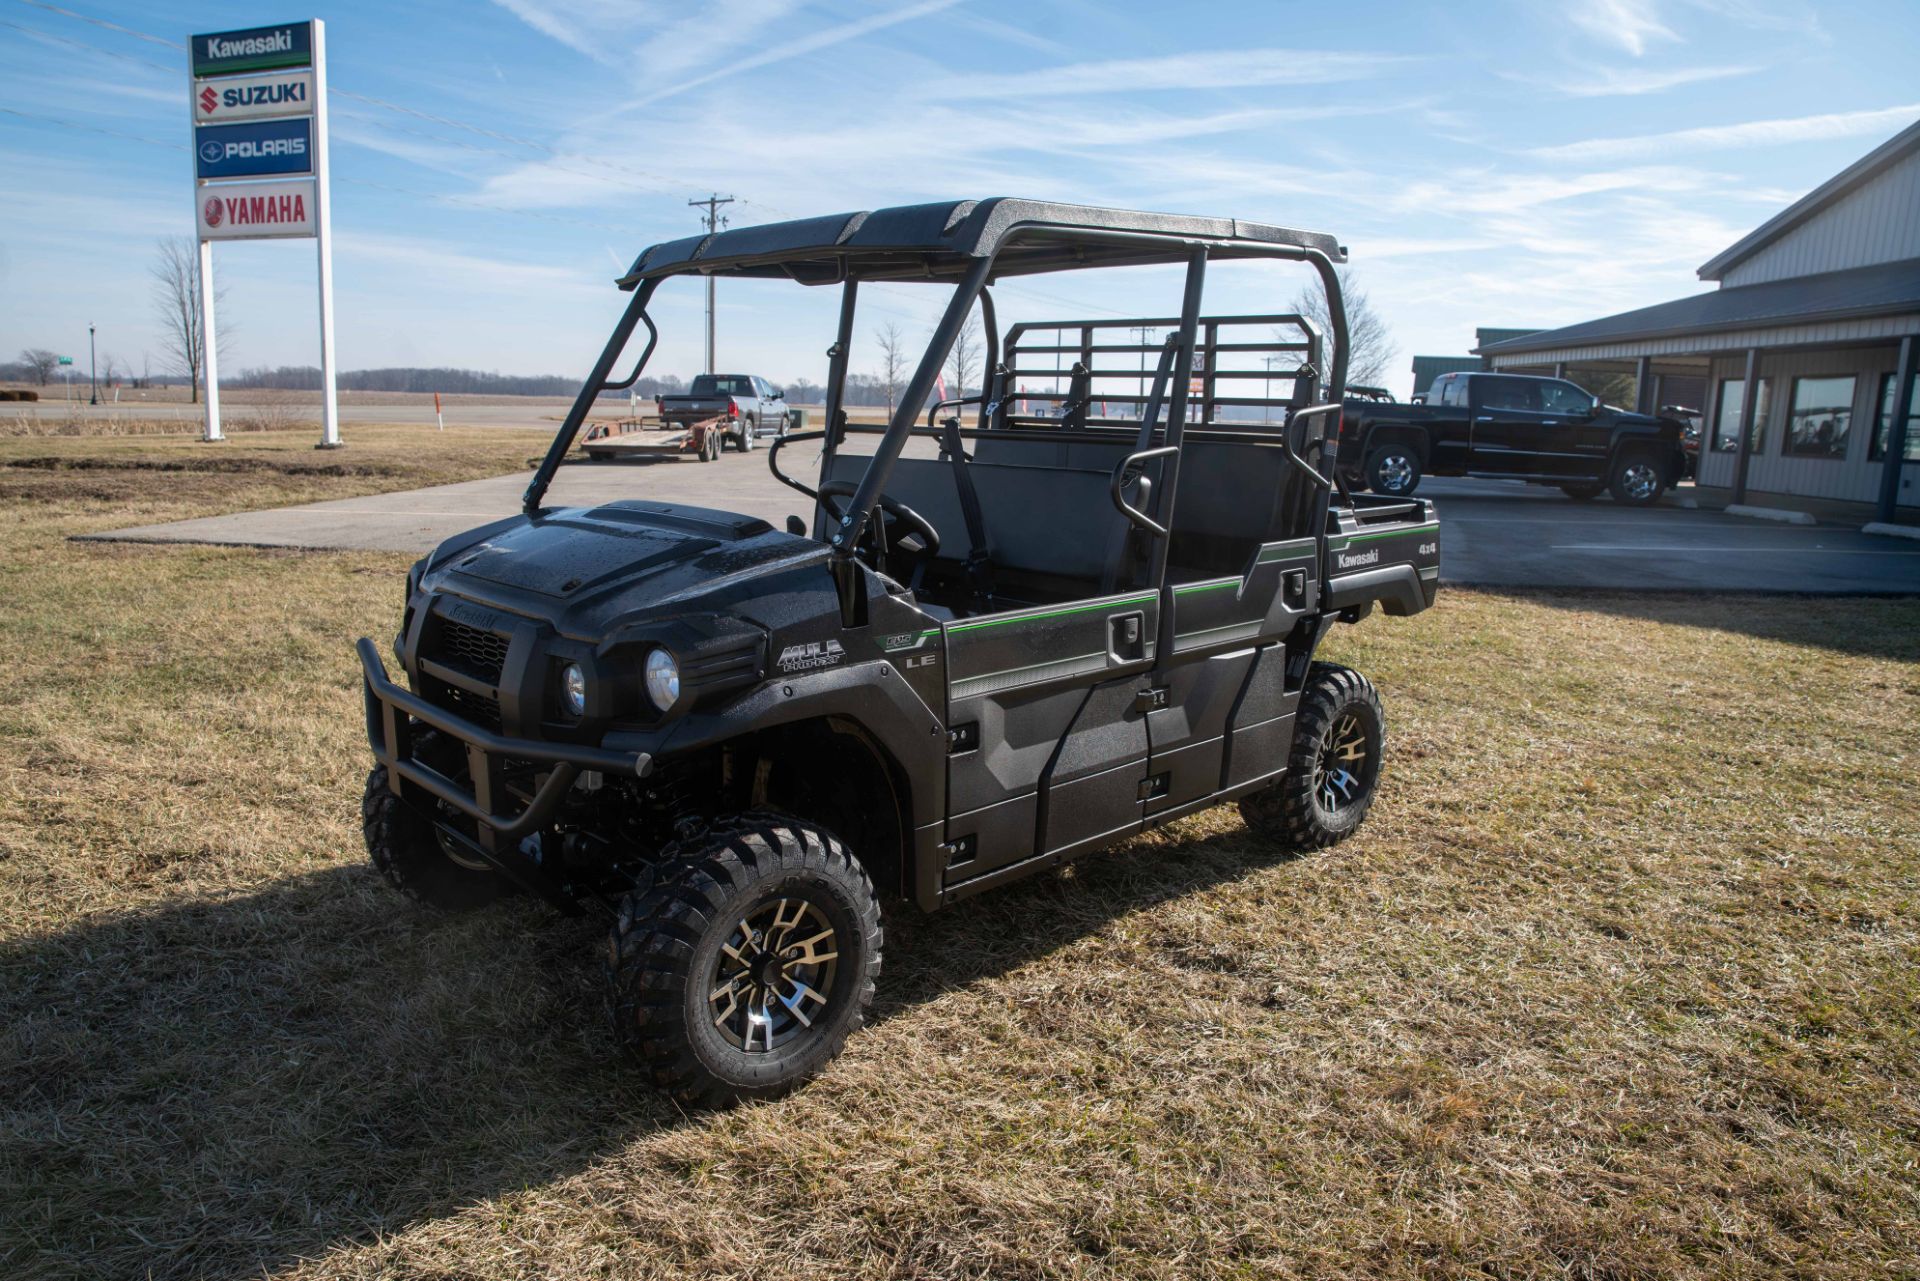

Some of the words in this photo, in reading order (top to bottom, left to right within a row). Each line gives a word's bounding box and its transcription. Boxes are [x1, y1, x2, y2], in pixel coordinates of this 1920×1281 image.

[208, 29, 292, 59] Kawasaki
[223, 82, 305, 108] SUZUKI
[225, 138, 305, 159] POLARIS
[226, 194, 305, 225] YAMAHA
[1338, 548, 1379, 568] Kawasaki
[1419, 543, 1436, 555] 4x4
[776, 639, 846, 666] MULE
[906, 655, 936, 669] LE
